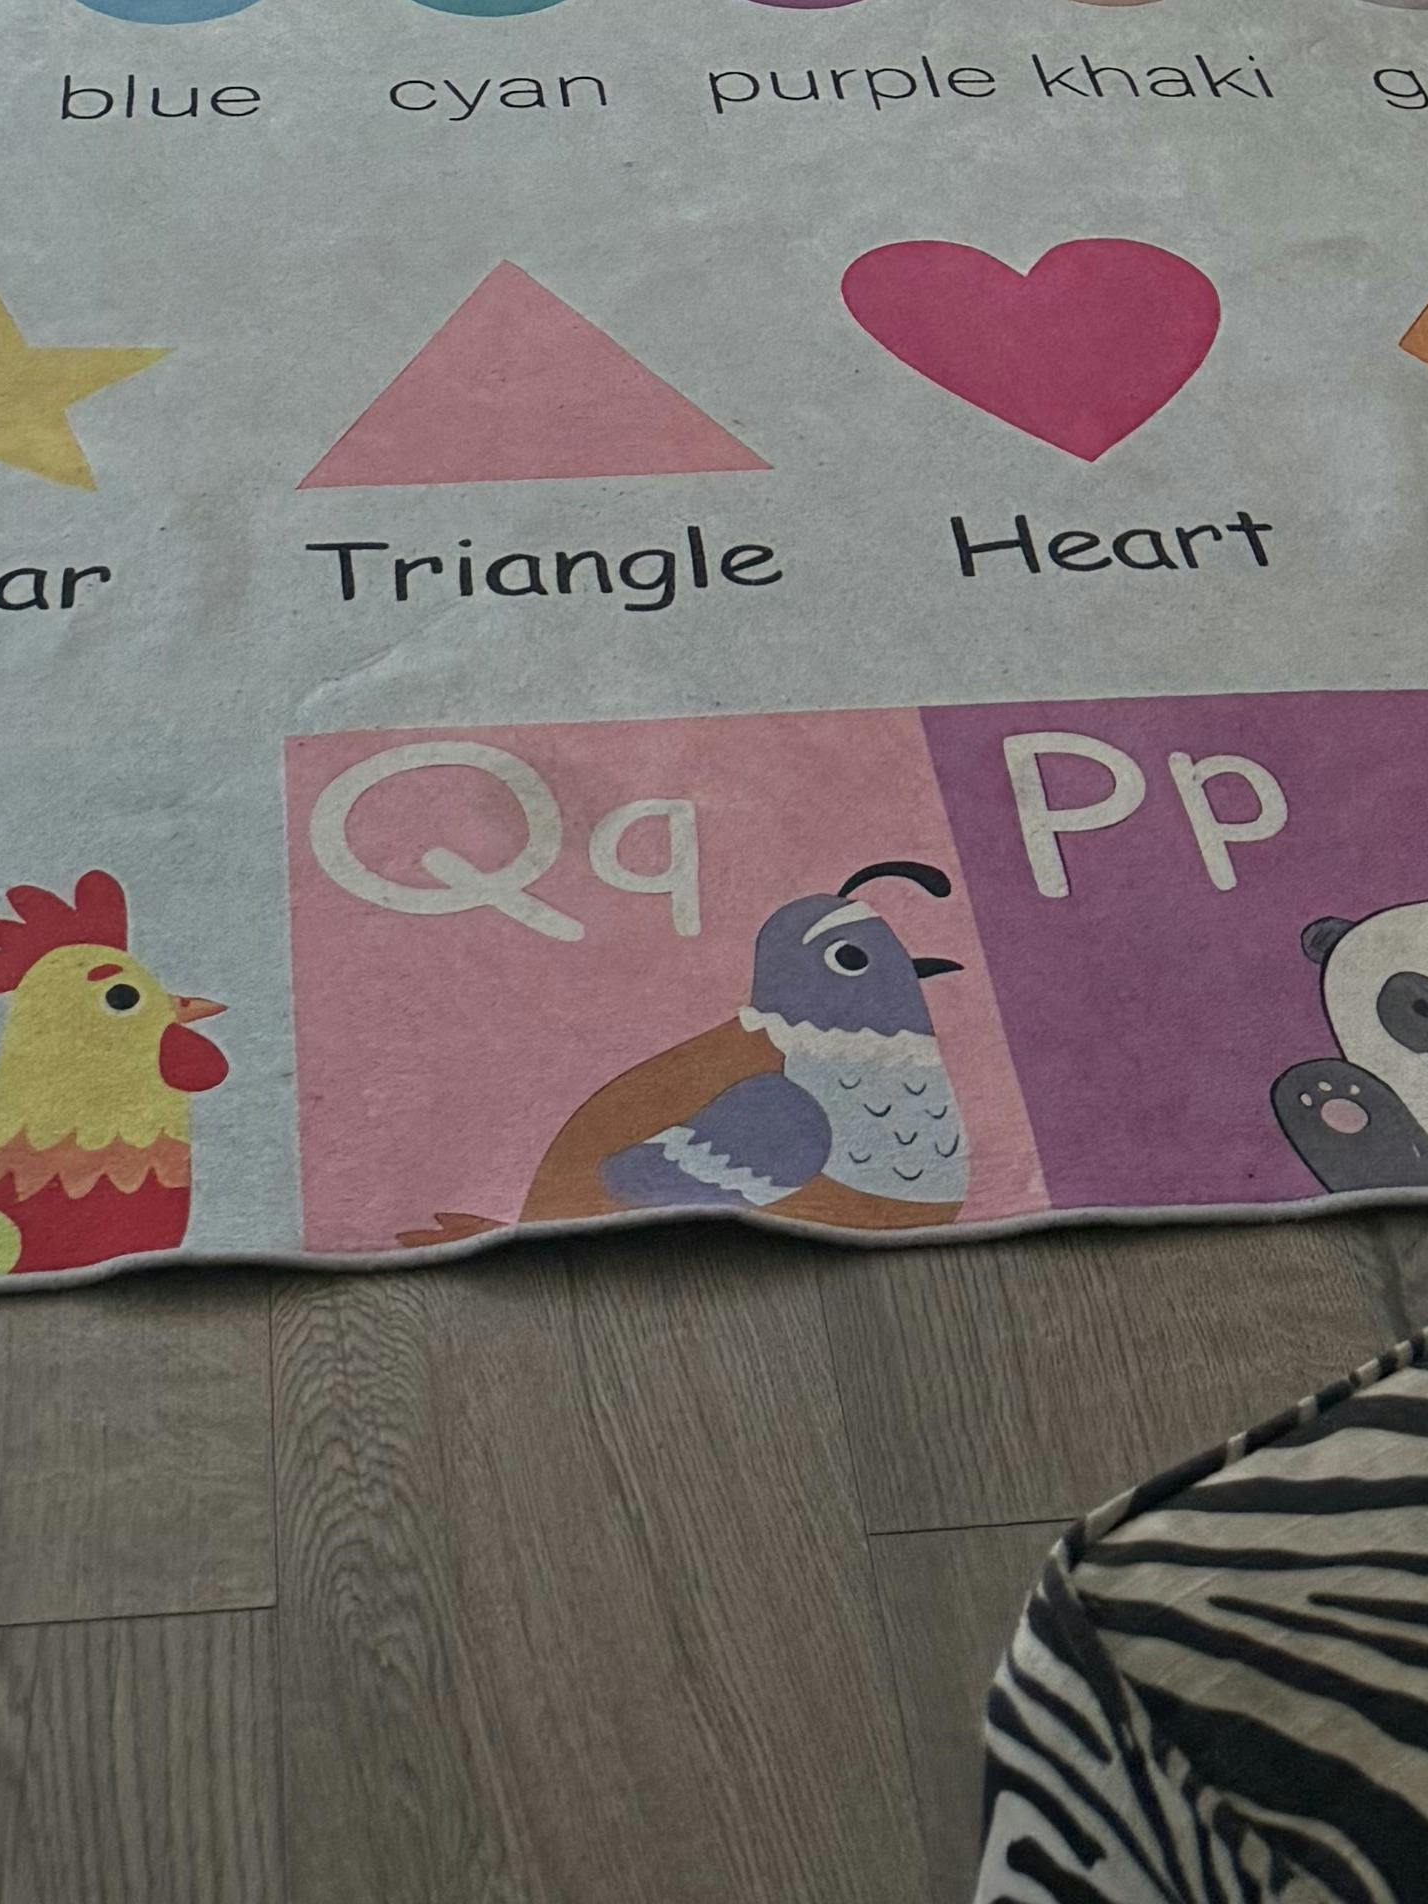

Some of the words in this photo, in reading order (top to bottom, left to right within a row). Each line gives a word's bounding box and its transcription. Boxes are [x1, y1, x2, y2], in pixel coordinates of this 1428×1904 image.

[58, 74, 264, 121] blue
[387, 70, 609, 120] cyan
[708, 55, 999, 114] purple
[1032, 53, 1275, 101] khaki
[304, 526, 783, 613] Triangle
[950, 510, 1272, 577] Heart
[309, 738, 701, 944] Qq
[1001, 729, 1290, 899] Pp
